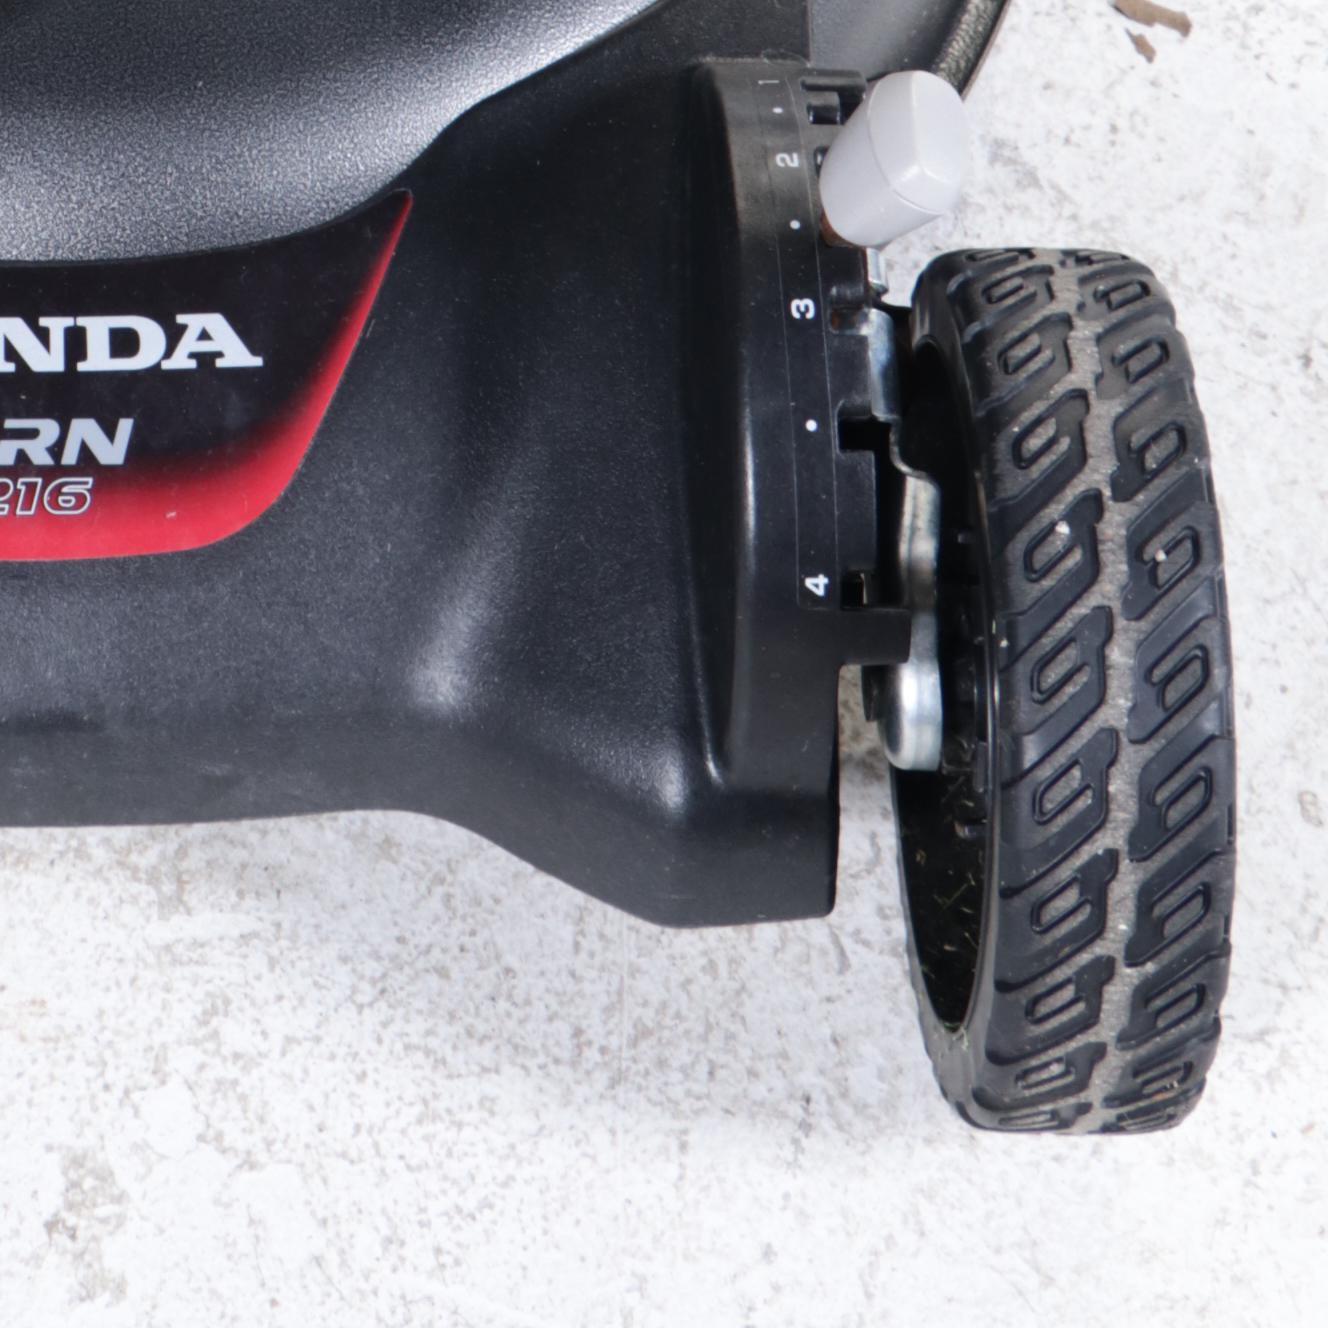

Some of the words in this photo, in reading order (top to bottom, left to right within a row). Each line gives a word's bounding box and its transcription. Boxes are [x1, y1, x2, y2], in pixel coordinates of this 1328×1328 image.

[775, 152, 800, 168] 2
[791, 297, 816, 321] 3
[804, 574, 830, 597] 4
